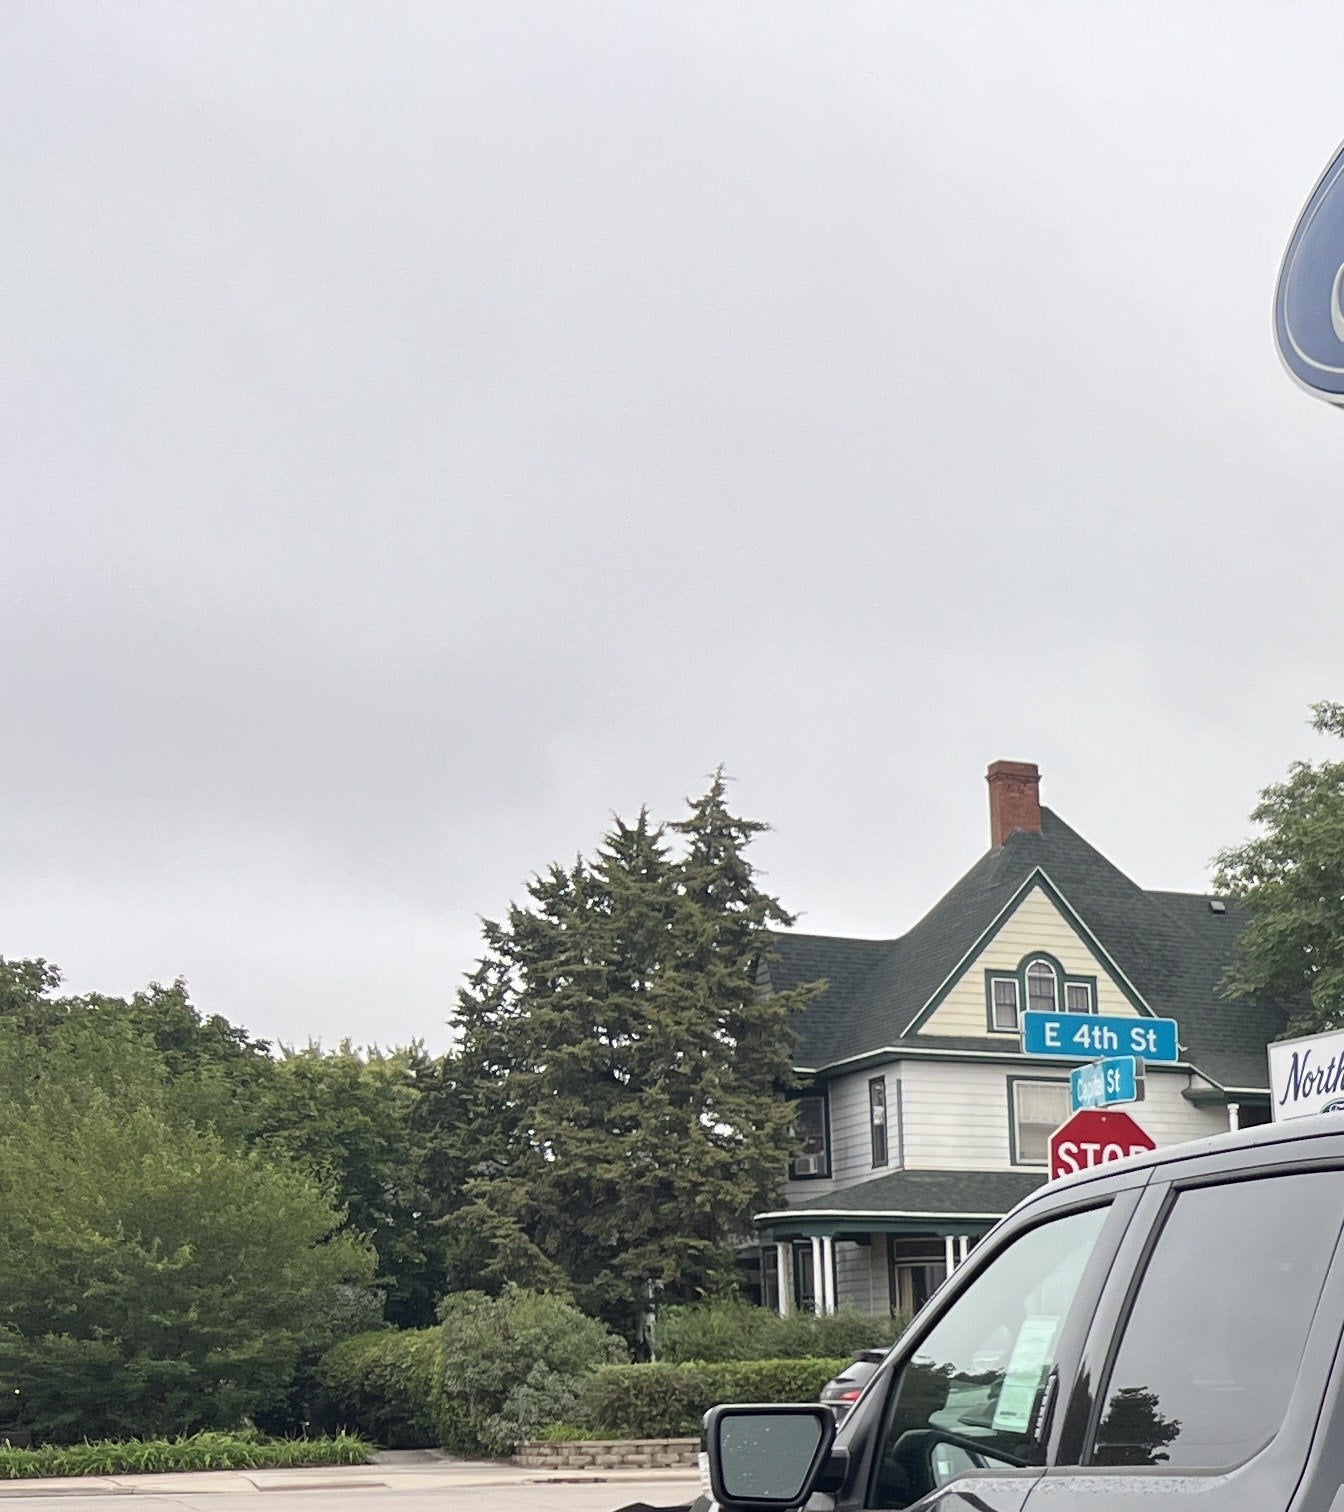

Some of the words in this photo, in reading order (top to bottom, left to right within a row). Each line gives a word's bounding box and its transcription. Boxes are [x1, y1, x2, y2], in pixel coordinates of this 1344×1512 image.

[1045, 1022, 1061, 1047] E
[1073, 1024, 1118, 1050] 4th
[1130, 1027, 1158, 1053] St
[1107, 1068, 1120, 1093] St
[1057, 1141, 1150, 1178] ST
